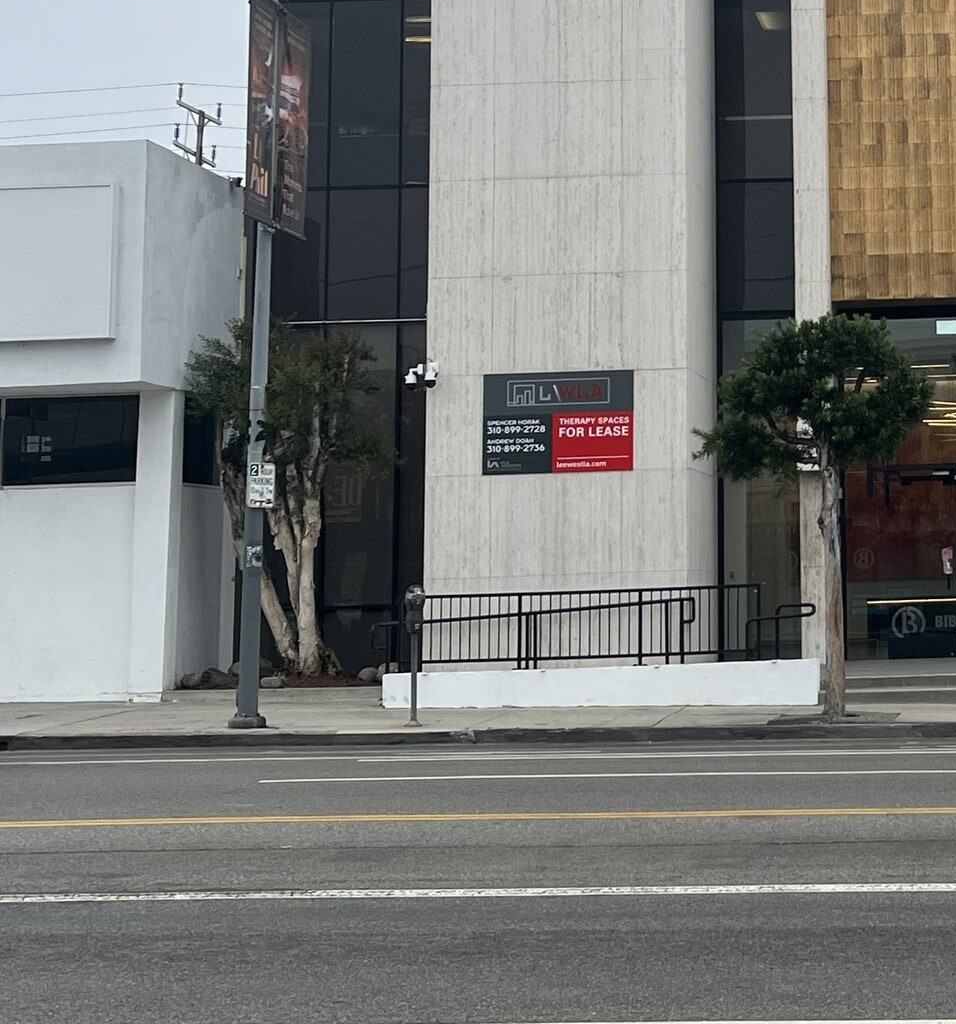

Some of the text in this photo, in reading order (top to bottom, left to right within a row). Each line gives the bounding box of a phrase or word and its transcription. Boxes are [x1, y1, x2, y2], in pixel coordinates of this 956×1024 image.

[559, 416, 630, 425] THERAPY SPACES
[486, 425, 546, 434] 310-899-2728
[559, 426, 629, 437] FOR LEASE
[486, 444, 545, 453] 310-899-2736
[251, 465, 258, 475] 2
